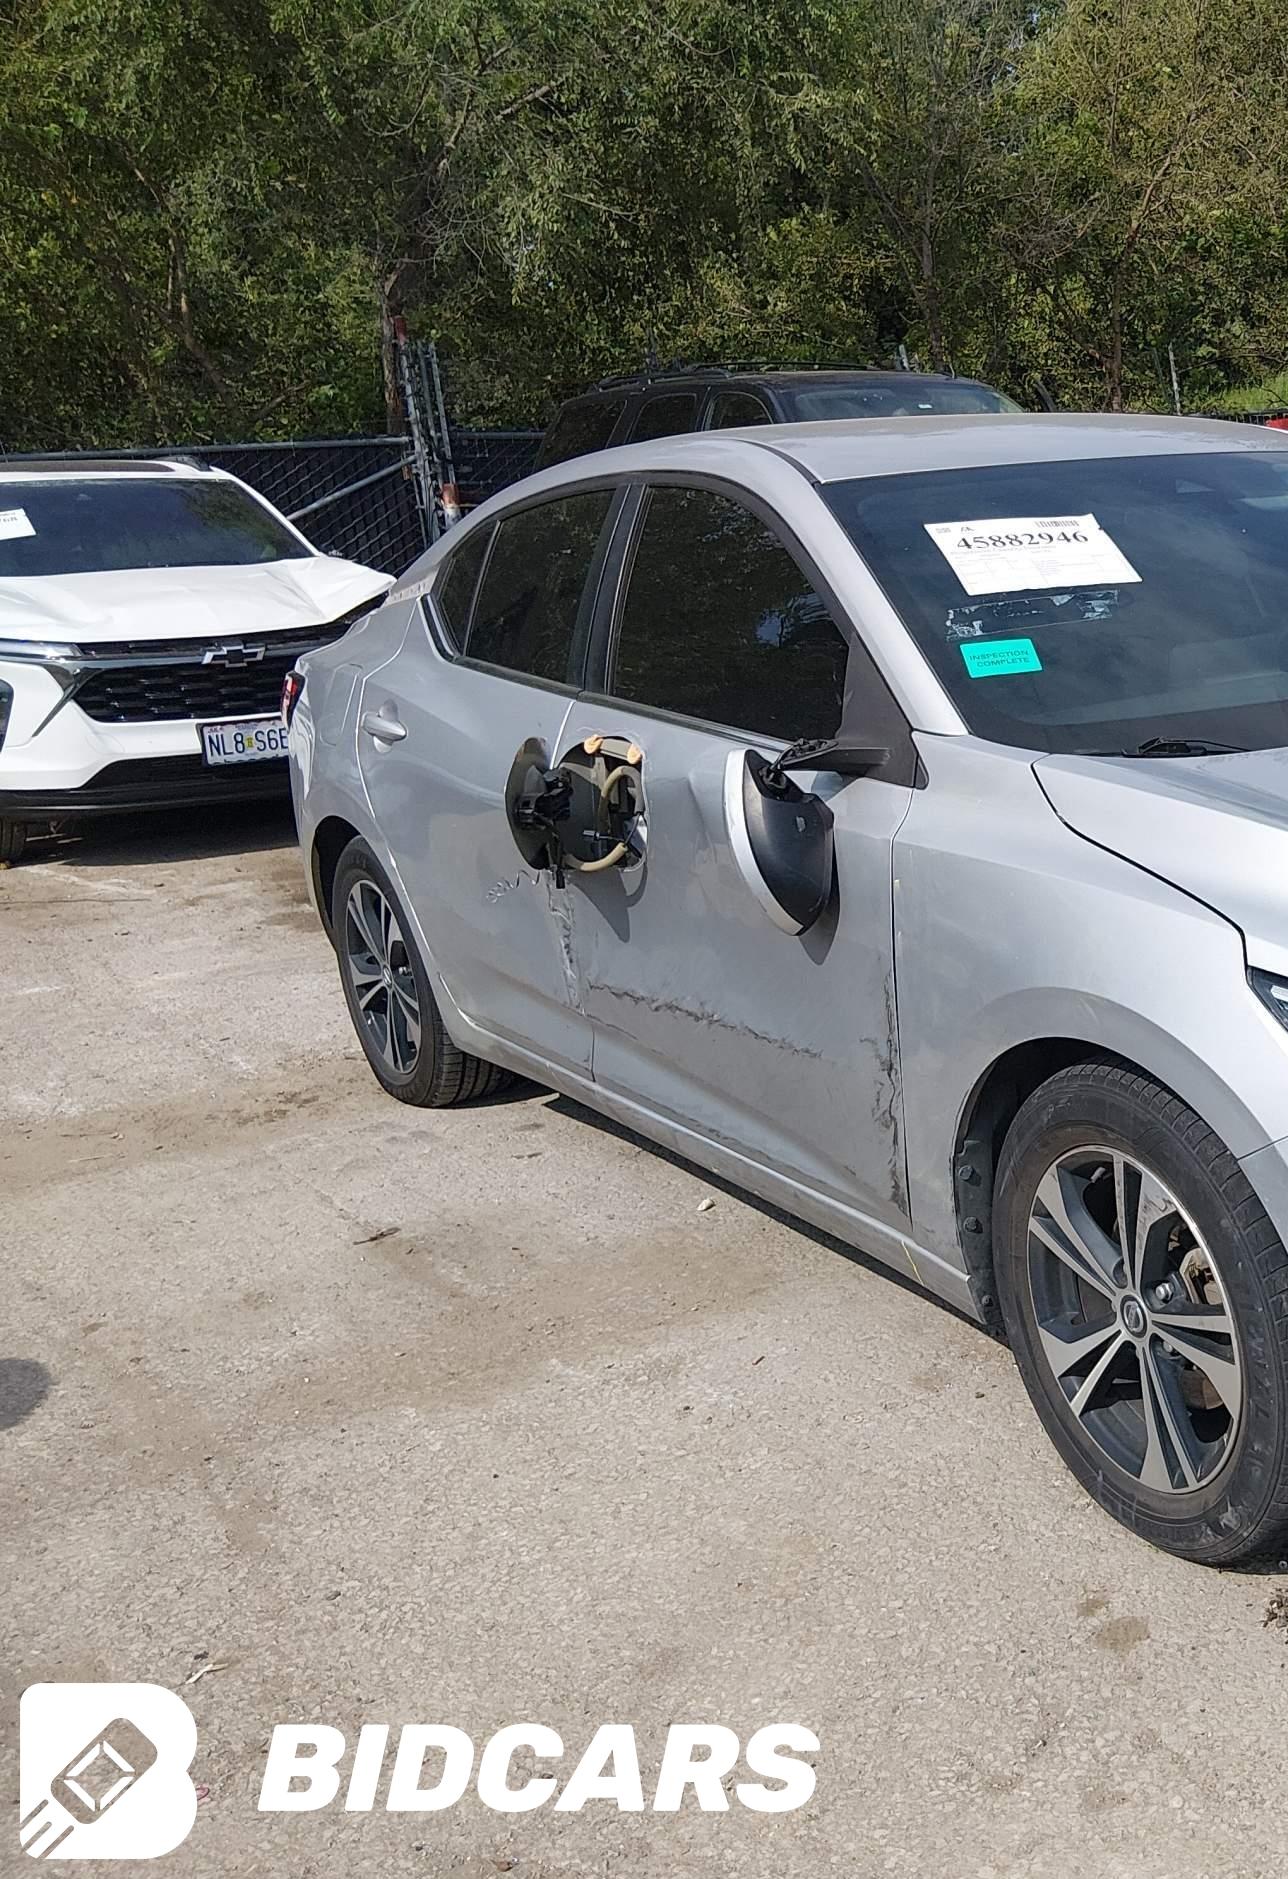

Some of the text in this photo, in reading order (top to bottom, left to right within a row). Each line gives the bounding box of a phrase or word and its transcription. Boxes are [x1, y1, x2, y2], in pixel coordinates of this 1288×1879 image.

[957, 530, 1088, 549] 45882946
[969, 650, 1030, 661] INSPECTION
[976, 657, 1031, 667] COMPLETE
[208, 732, 245, 757] NL8
